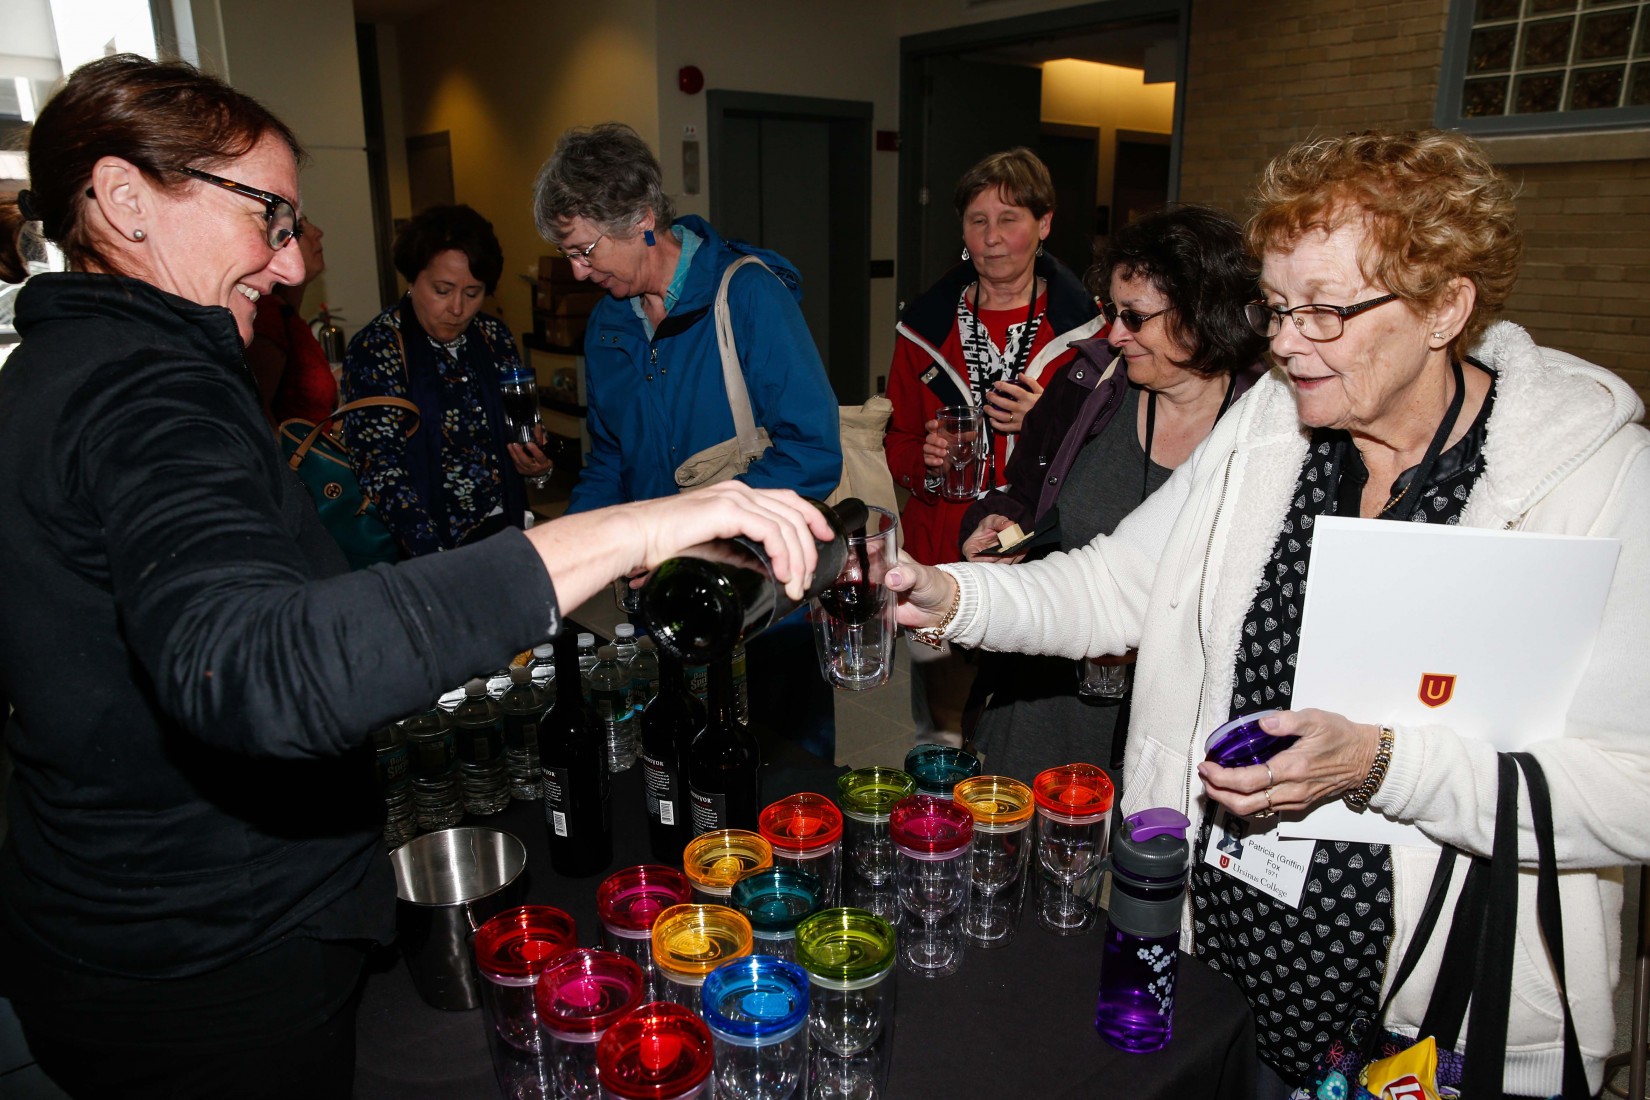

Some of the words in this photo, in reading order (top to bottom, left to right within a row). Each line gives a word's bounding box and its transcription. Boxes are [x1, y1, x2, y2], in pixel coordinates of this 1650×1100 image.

[1427, 680, 1446, 700] U
[1248, 839, 1275, 858] Patricia
[1276, 853, 1305, 874] (Griffin)
[1266, 859, 1281, 871] Fox
[1232, 863, 1259, 883] Ursinus
[1260, 877, 1288, 898] College
[1265, 868, 1278, 878] 1971
